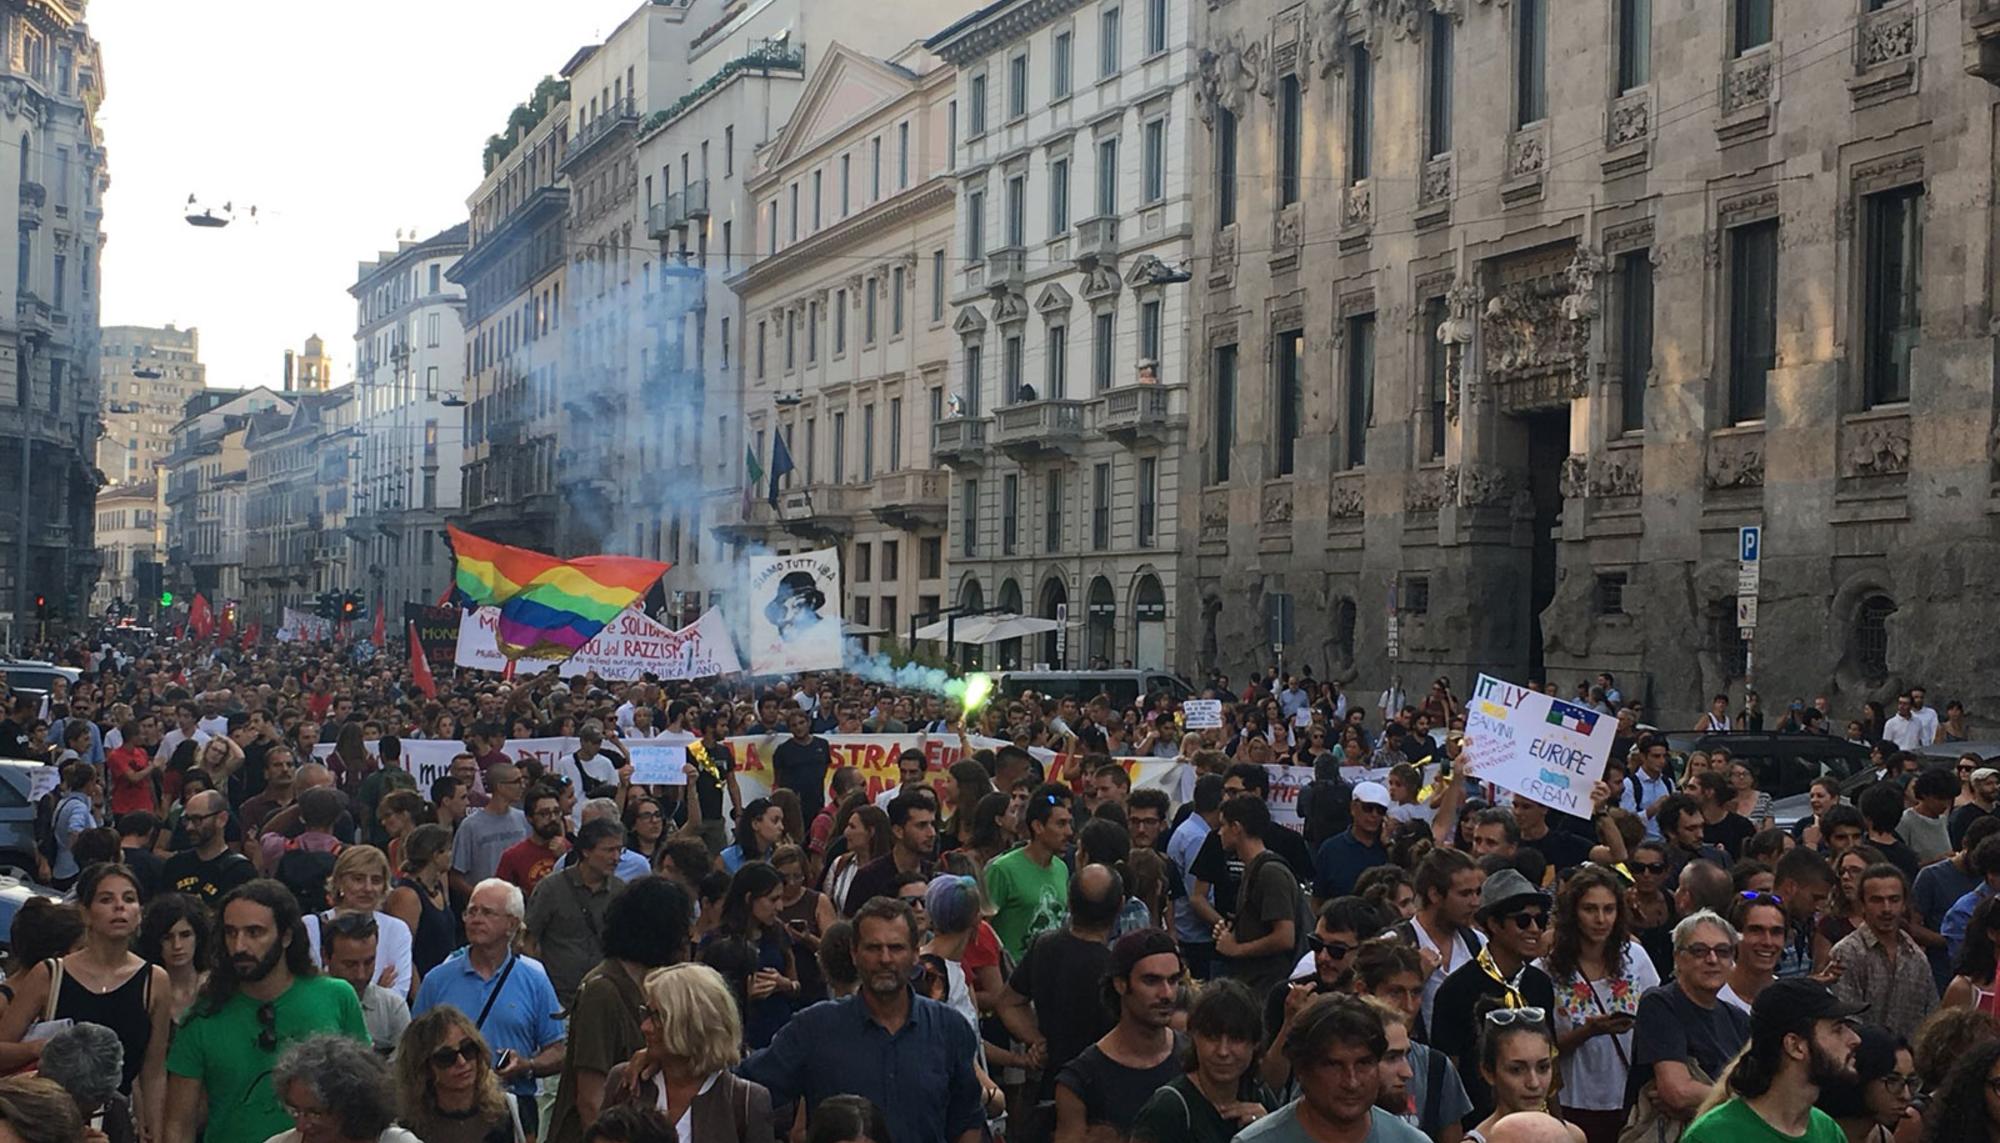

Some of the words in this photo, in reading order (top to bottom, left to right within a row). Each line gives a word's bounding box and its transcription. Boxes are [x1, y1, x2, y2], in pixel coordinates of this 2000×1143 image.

[1745, 533, 1755, 557] P
[752, 562, 784, 590] SIAMO
[785, 559, 817, 570] TUTTI
[604, 640, 619, 656] dal
[1469, 711, 1514, 740] SALVINI
[828, 743, 902, 775] STRA
[1528, 738, 1593, 776] EUROPE
